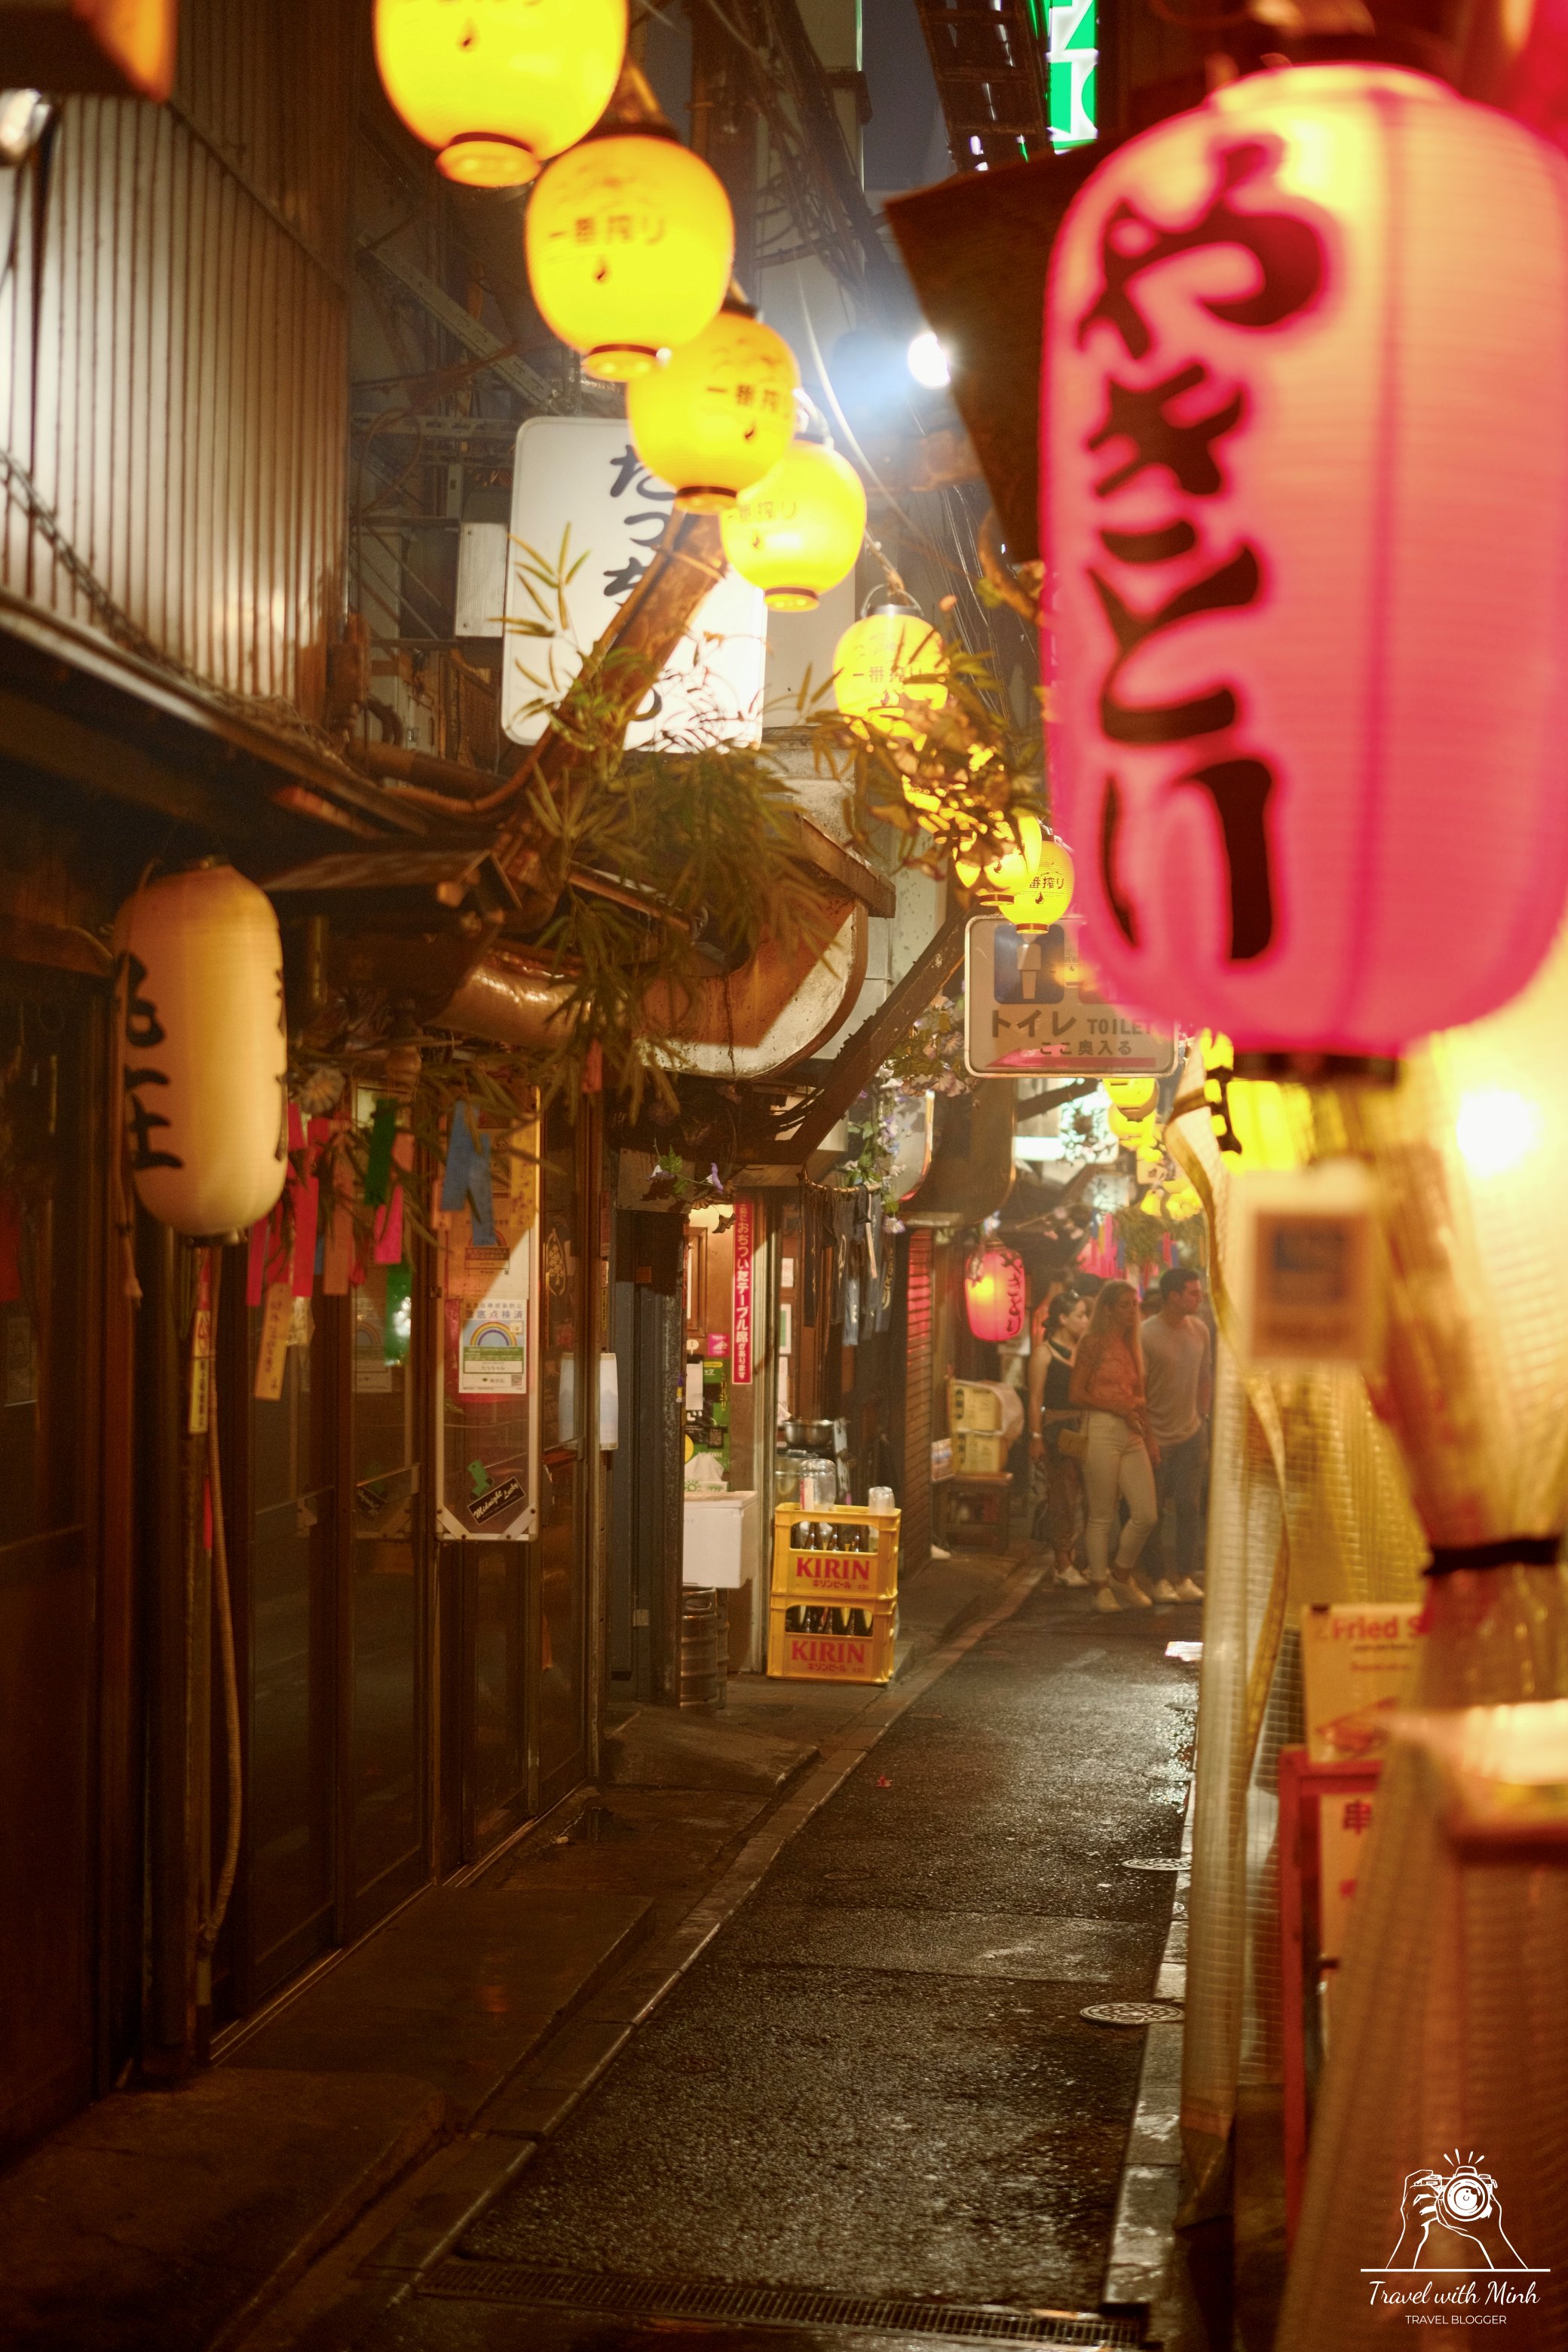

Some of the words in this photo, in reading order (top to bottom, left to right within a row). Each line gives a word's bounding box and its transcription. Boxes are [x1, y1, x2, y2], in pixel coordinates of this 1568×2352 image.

[1078, 132, 1329, 961] やきとり
[1029, 877, 1064, 890] 番搾り
[992, 1009, 1076, 1038] トイレ
[1087, 1018, 1152, 1035] TOILET
[1040, 1040, 1132, 1055] ここ奥入る
[796, 1557, 870, 1581] KIRIN
[813, 1579, 852, 1590] キリンビール
[792, 1640, 865, 1664] KIRIN
